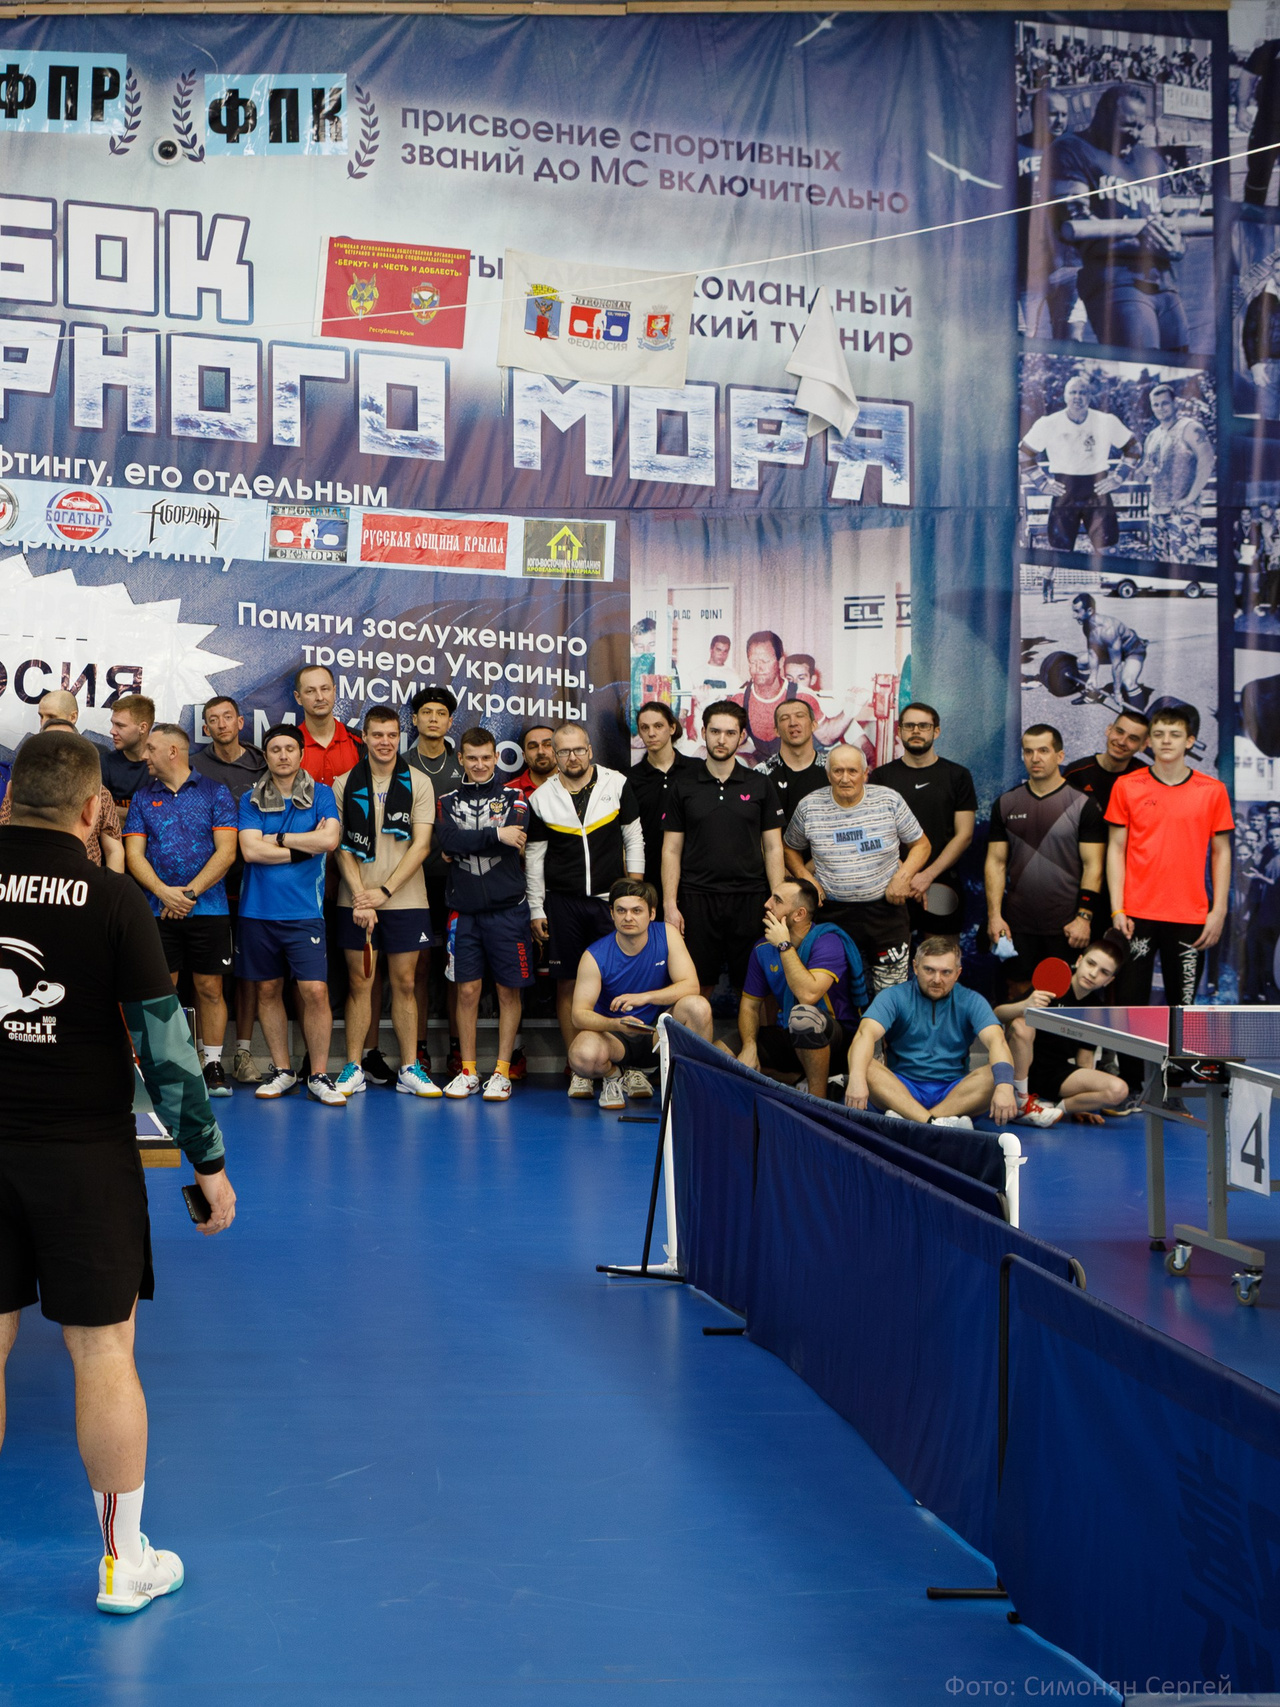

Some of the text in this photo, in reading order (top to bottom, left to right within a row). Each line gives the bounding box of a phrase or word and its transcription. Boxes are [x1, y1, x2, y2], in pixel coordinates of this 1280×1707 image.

[208, 87, 343, 144] ФПК
[400, 104, 841, 173] присвоение спортивных
[401, 138, 910, 215] званий до МС включительно
[694, 275, 912, 318] оманный
[567, 337, 628, 351] ФЕОДОСИЯ
[770, 320, 914, 362] тунир
[511, 366, 914, 506] МОРЯ
[124, 462, 183, 488] его
[193, 468, 387, 507] отдельным
[46, 509, 113, 528] БОГАТЫРЬ
[363, 529, 504, 554] РУССКАЯ ОБЩИНА КРЫМА
[238, 602, 588, 657] Памяти заслуженного
[302, 644, 595, 694] тренера Украины,
[835, 829, 864, 843] MASTIFF
[860, 838, 882, 852] JEAN
[517, 942, 530, 979] RUSSIA
[4, 1021, 57, 1034] ФНТ
[8, 1033, 57, 1043] ФЕОДОСИЯ РК
[1240, 1112, 1265, 1185] 4
